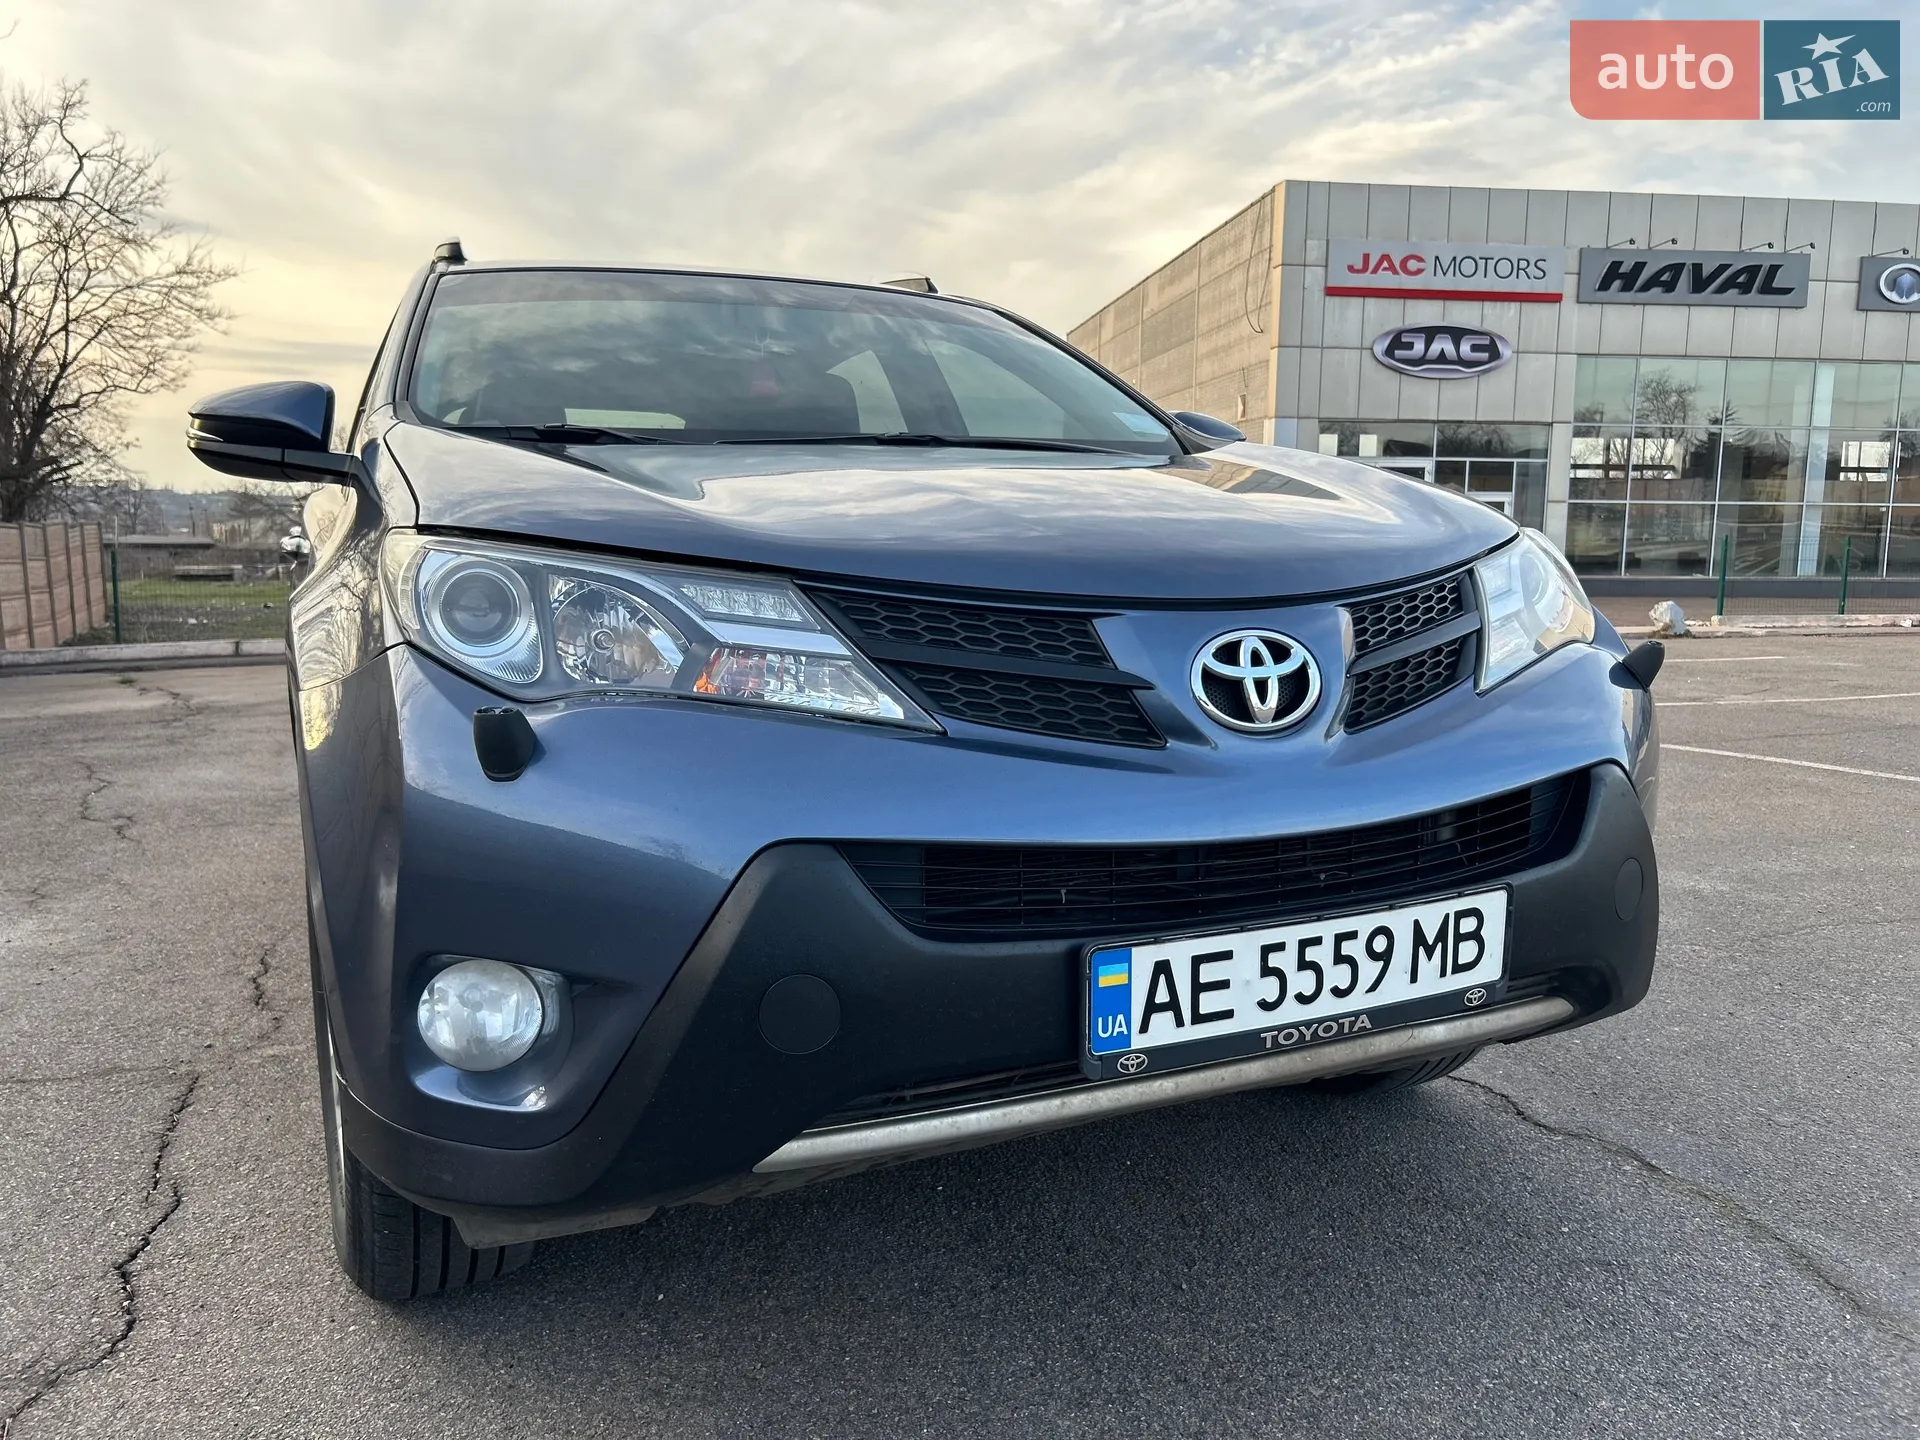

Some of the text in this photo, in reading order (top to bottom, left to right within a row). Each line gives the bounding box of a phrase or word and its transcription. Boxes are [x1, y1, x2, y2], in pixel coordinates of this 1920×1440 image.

[1346, 252, 1547, 281] JAC MOTORS
[1595, 260, 1796, 296] HAVAL
[1394, 333, 1491, 362] JAC
[1137, 907, 1485, 1035] AE 5559 MB
[1097, 1013, 1129, 1038] UA
[1260, 1014, 1373, 1049] TOYOTA
